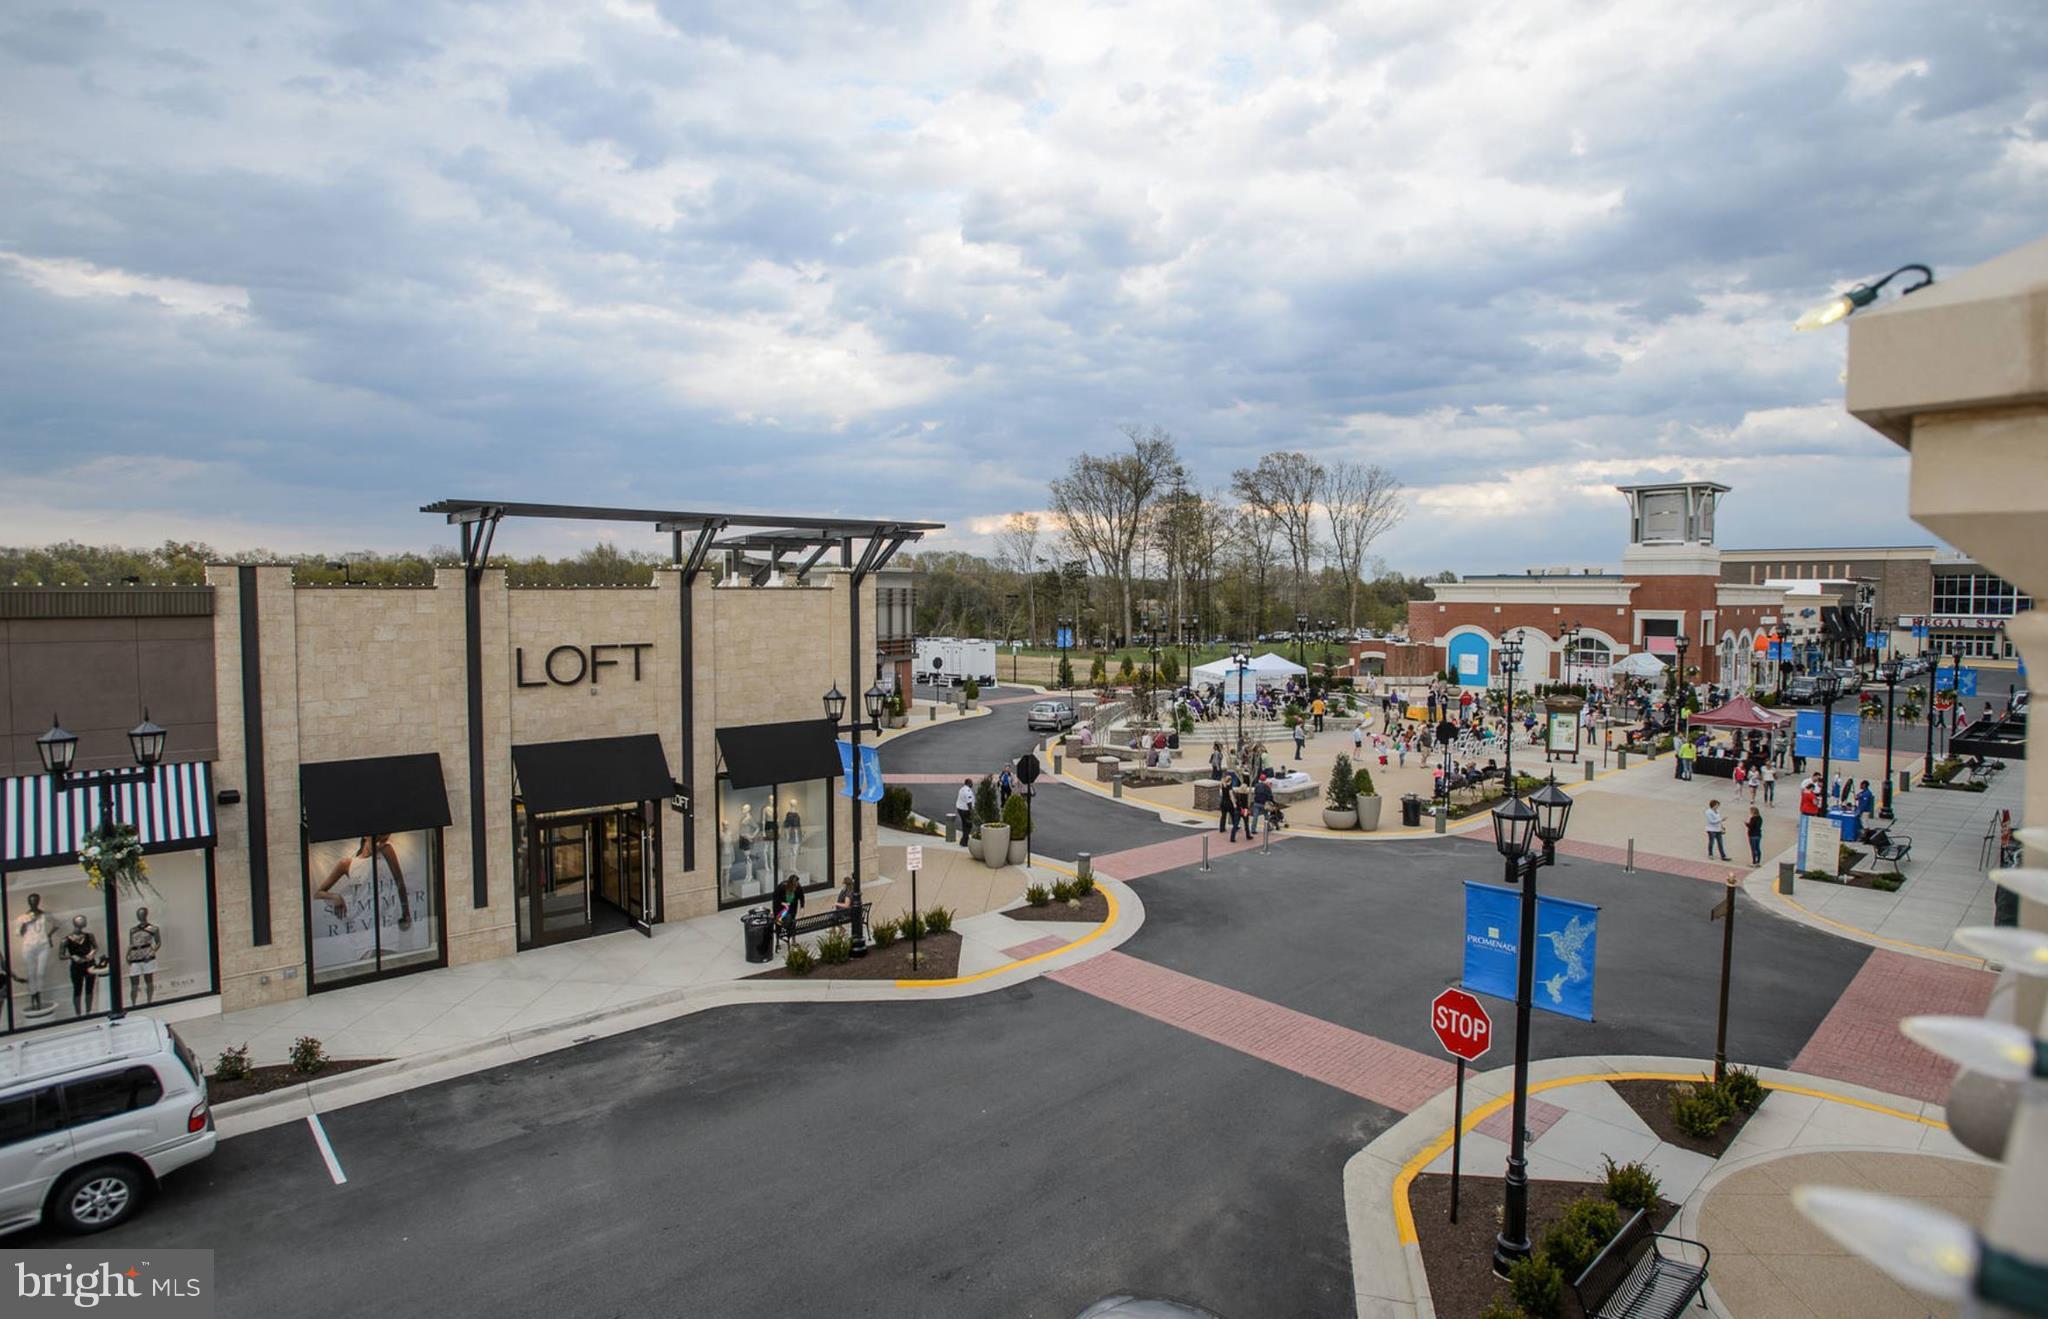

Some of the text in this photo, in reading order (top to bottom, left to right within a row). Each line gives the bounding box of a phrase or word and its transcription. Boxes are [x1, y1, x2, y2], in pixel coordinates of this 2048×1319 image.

[1912, 617, 1966, 629] REGAL
[516, 643, 653, 688] LOFT
[672, 794, 689, 809] LOFT
[328, 910, 424, 937] REVEL
[1435, 1005, 1487, 1041] STOP
